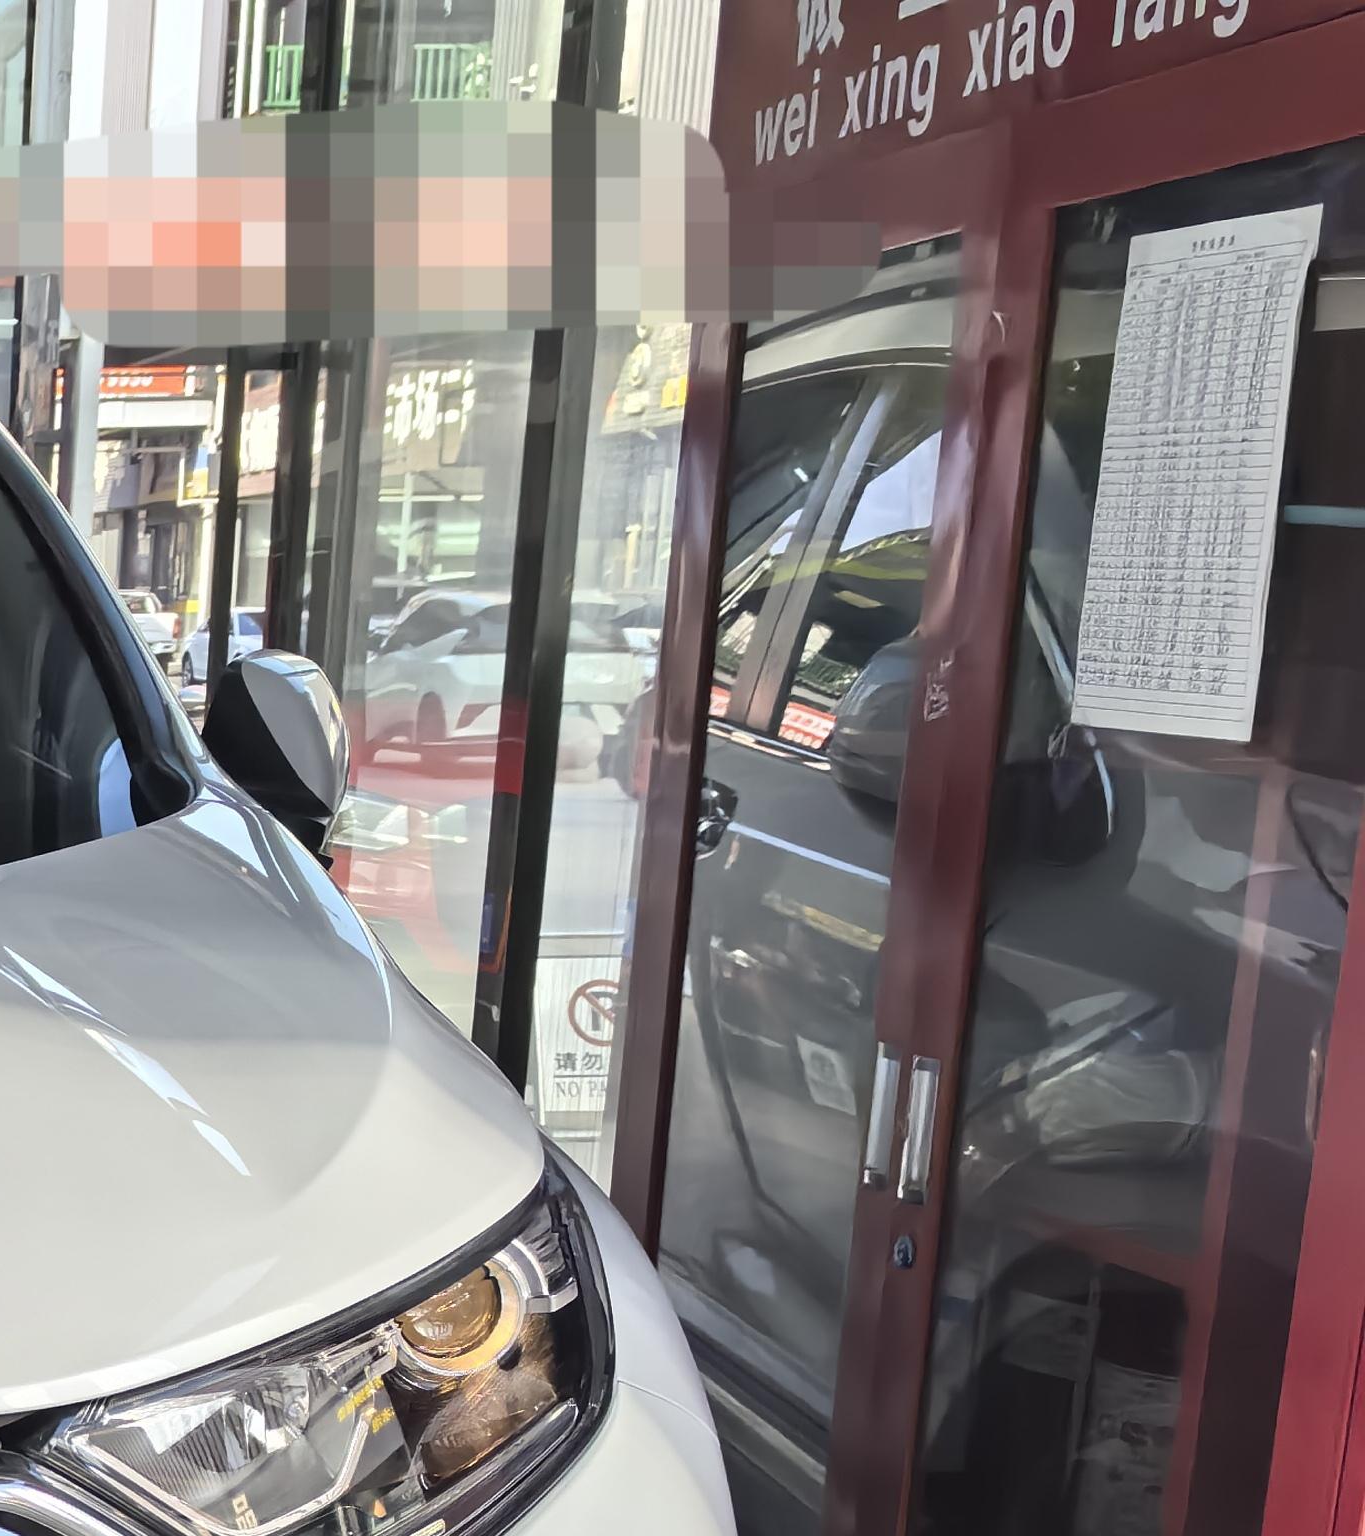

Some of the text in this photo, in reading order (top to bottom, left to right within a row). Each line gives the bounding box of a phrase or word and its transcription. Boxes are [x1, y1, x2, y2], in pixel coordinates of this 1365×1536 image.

[755, 69, 820, 167] wei
[838, 44, 940, 138] xing
[962, 0, 1075, 99] xiao
[554, 1052, 603, 1072] 请勿
[555, 1081, 580, 1099] NO
